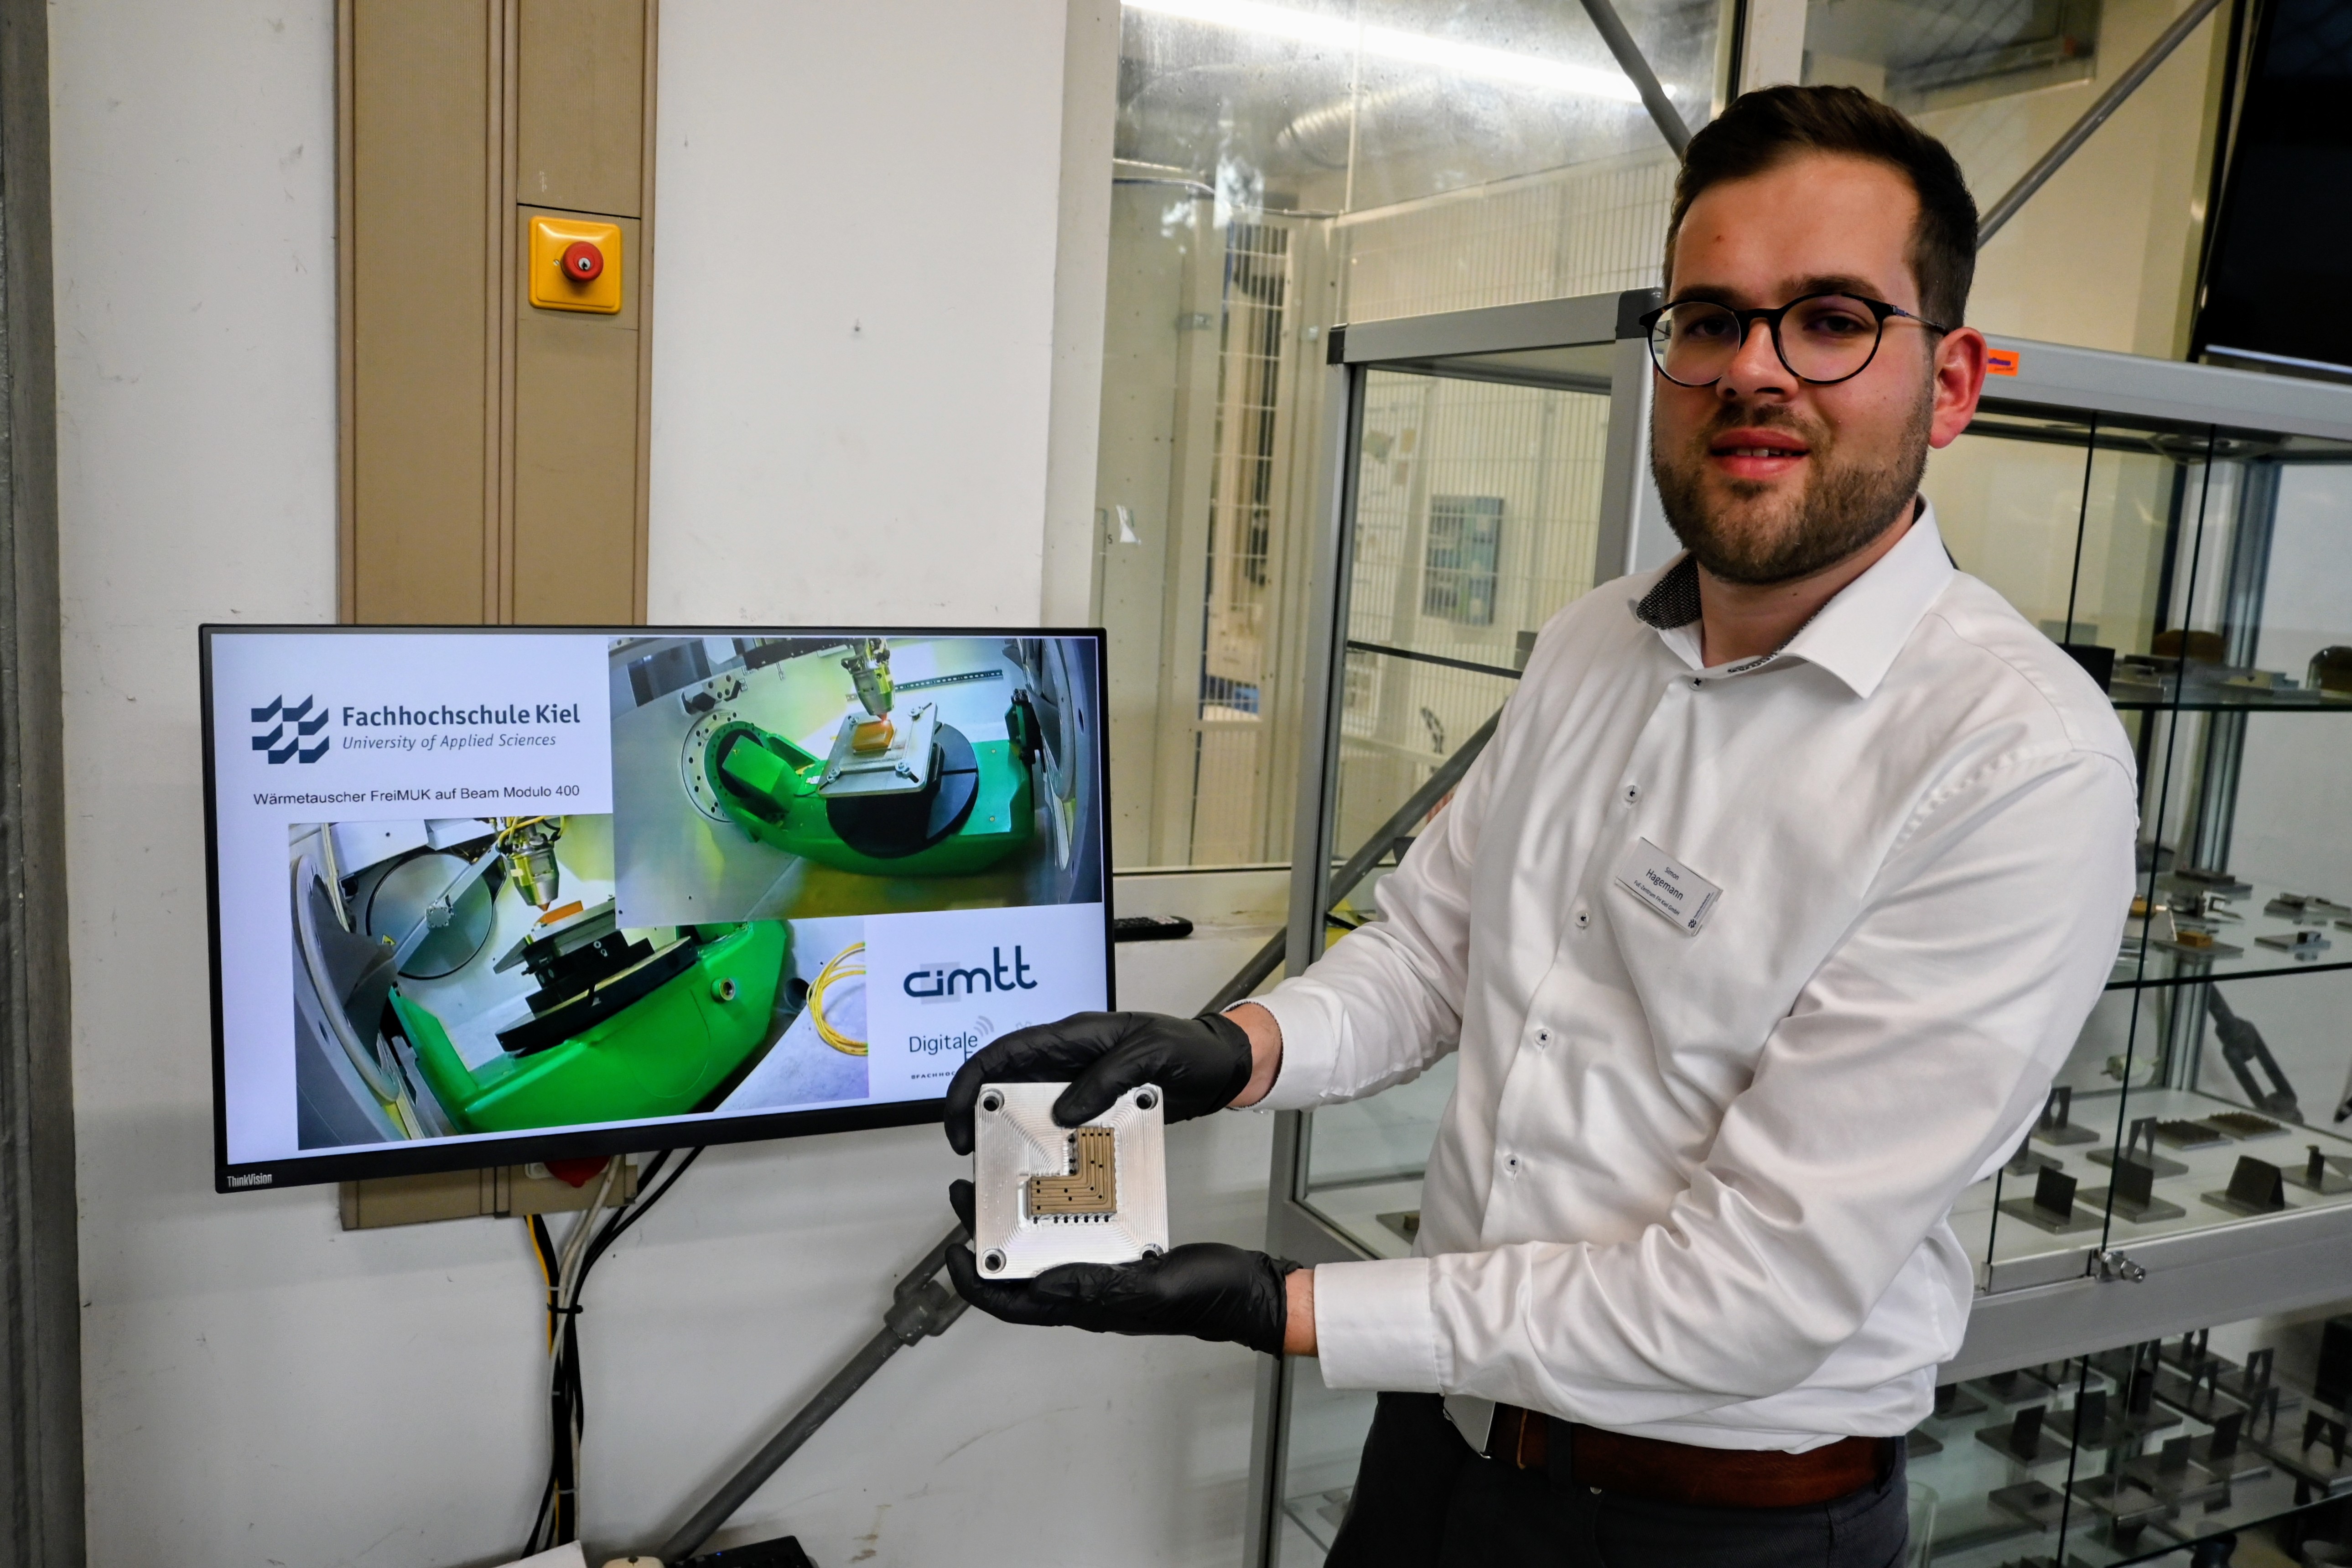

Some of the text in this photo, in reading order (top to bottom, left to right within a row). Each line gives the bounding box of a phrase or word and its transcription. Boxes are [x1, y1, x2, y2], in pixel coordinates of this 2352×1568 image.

[343, 703, 581, 726] Fachhochschule Kiel
[343, 733, 556, 752] University of Applied Sciences
[253, 785, 580, 805] Wärmetauscher FreiMUK auf Beam Modulo 400
[1664, 867, 1680, 881] Simon
[1646, 868, 1683, 901] Hagemann
[1661, 899, 1669, 908] Kiel
[1667, 904, 1680, 916] GmbH
[903, 945, 1038, 997] cimtt
[909, 1031, 978, 1056] Digitale
[227, 1173, 272, 1188] ThinkVision
